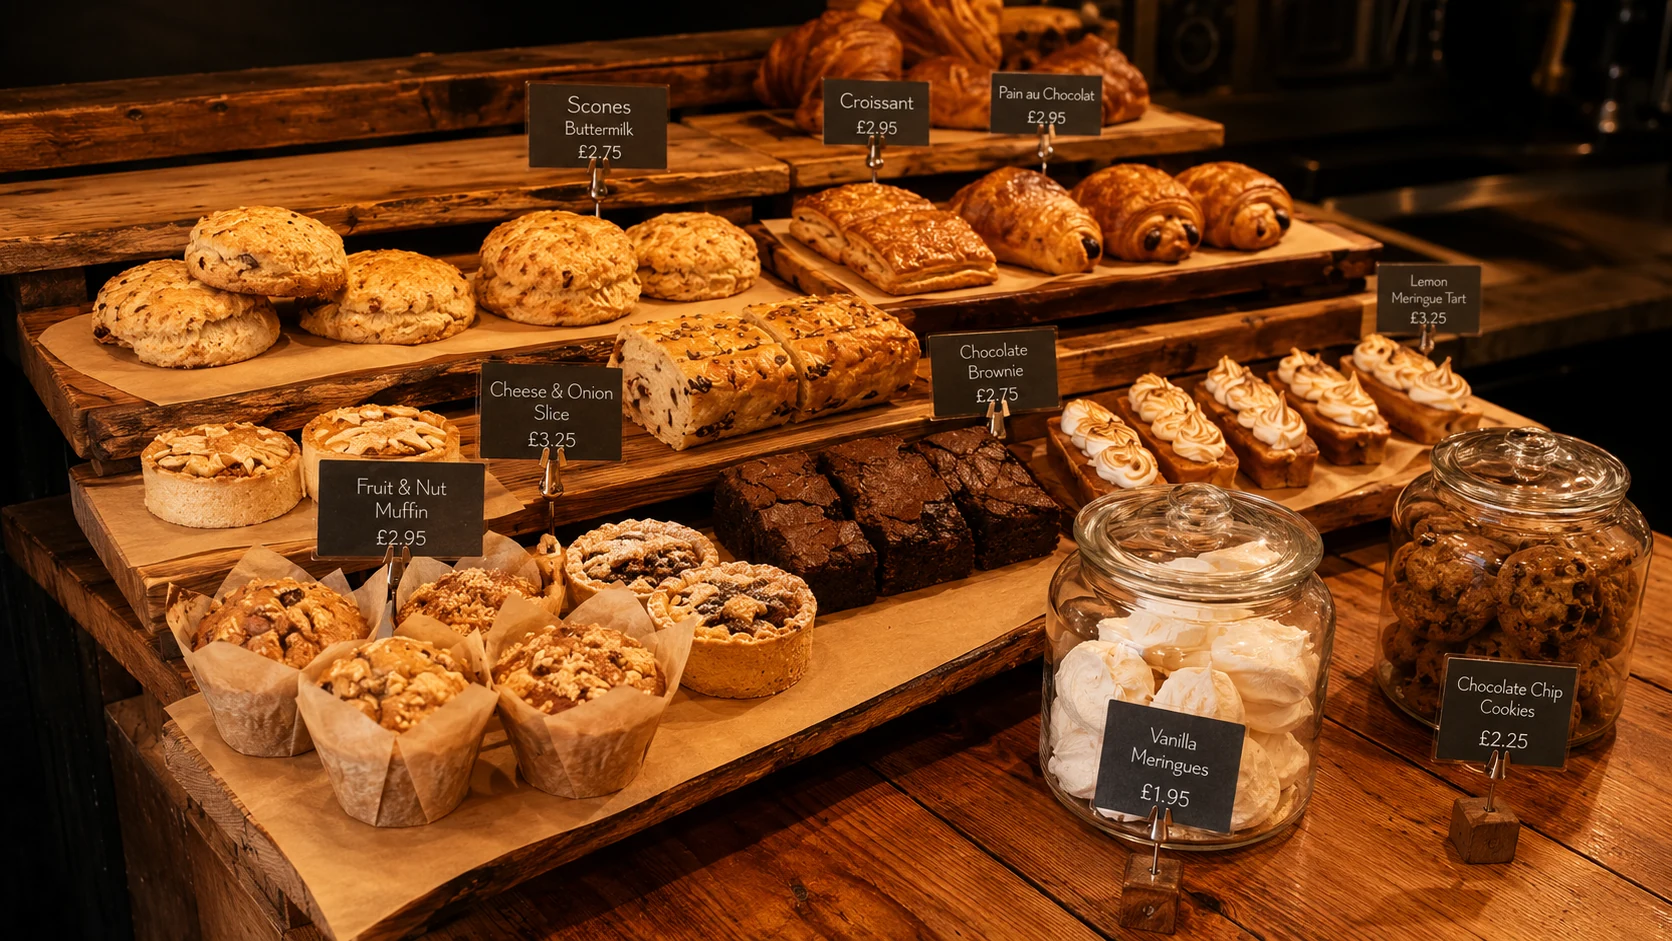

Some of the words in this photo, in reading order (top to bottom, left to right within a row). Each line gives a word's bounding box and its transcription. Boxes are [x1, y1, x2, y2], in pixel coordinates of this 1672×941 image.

[999, 85, 1023, 100] Pain
[1025, 91, 1040, 101] au
[1042, 87, 1095, 102] Chocolat
[568, 96, 632, 115] Scones
[840, 93, 914, 111] Croissant
[1027, 110, 1066, 125] £2.95
[566, 121, 633, 136] Buttermilk
[856, 120, 898, 136] £2.95
[577, 144, 622, 160] £2.75
[1411, 275, 1447, 286] Lemon
[1391, 291, 1442, 307] Meringue
[1444, 292, 1467, 304] Tart
[1410, 311, 1447, 325] £3.25
[960, 343, 1028, 359] Chocolate
[969, 365, 1023, 379] Brownie
[491, 381, 546, 398] Cheese
[551, 382, 563, 399] &
[568, 383, 614, 400] Onion
[976, 387, 1019, 403] £2.75
[535, 404, 569, 420] Slice
[528, 432, 576, 448] £3.25
[357, 478, 393, 495] Fruit
[398, 478, 411, 496] &
[417, 479, 446, 495] Nut
[376, 502, 427, 518] Muffin
[376, 530, 427, 546] £2.95
[1457, 676, 1528, 696] Chocolate
[1531, 680, 1564, 703] Chip
[1481, 699, 1534, 717] Cookies
[1151, 727, 1196, 750] Vanilla
[1479, 730, 1528, 749] £2.25
[1131, 746, 1209, 776] Meringues
[1141, 784, 1190, 807] £1.95
